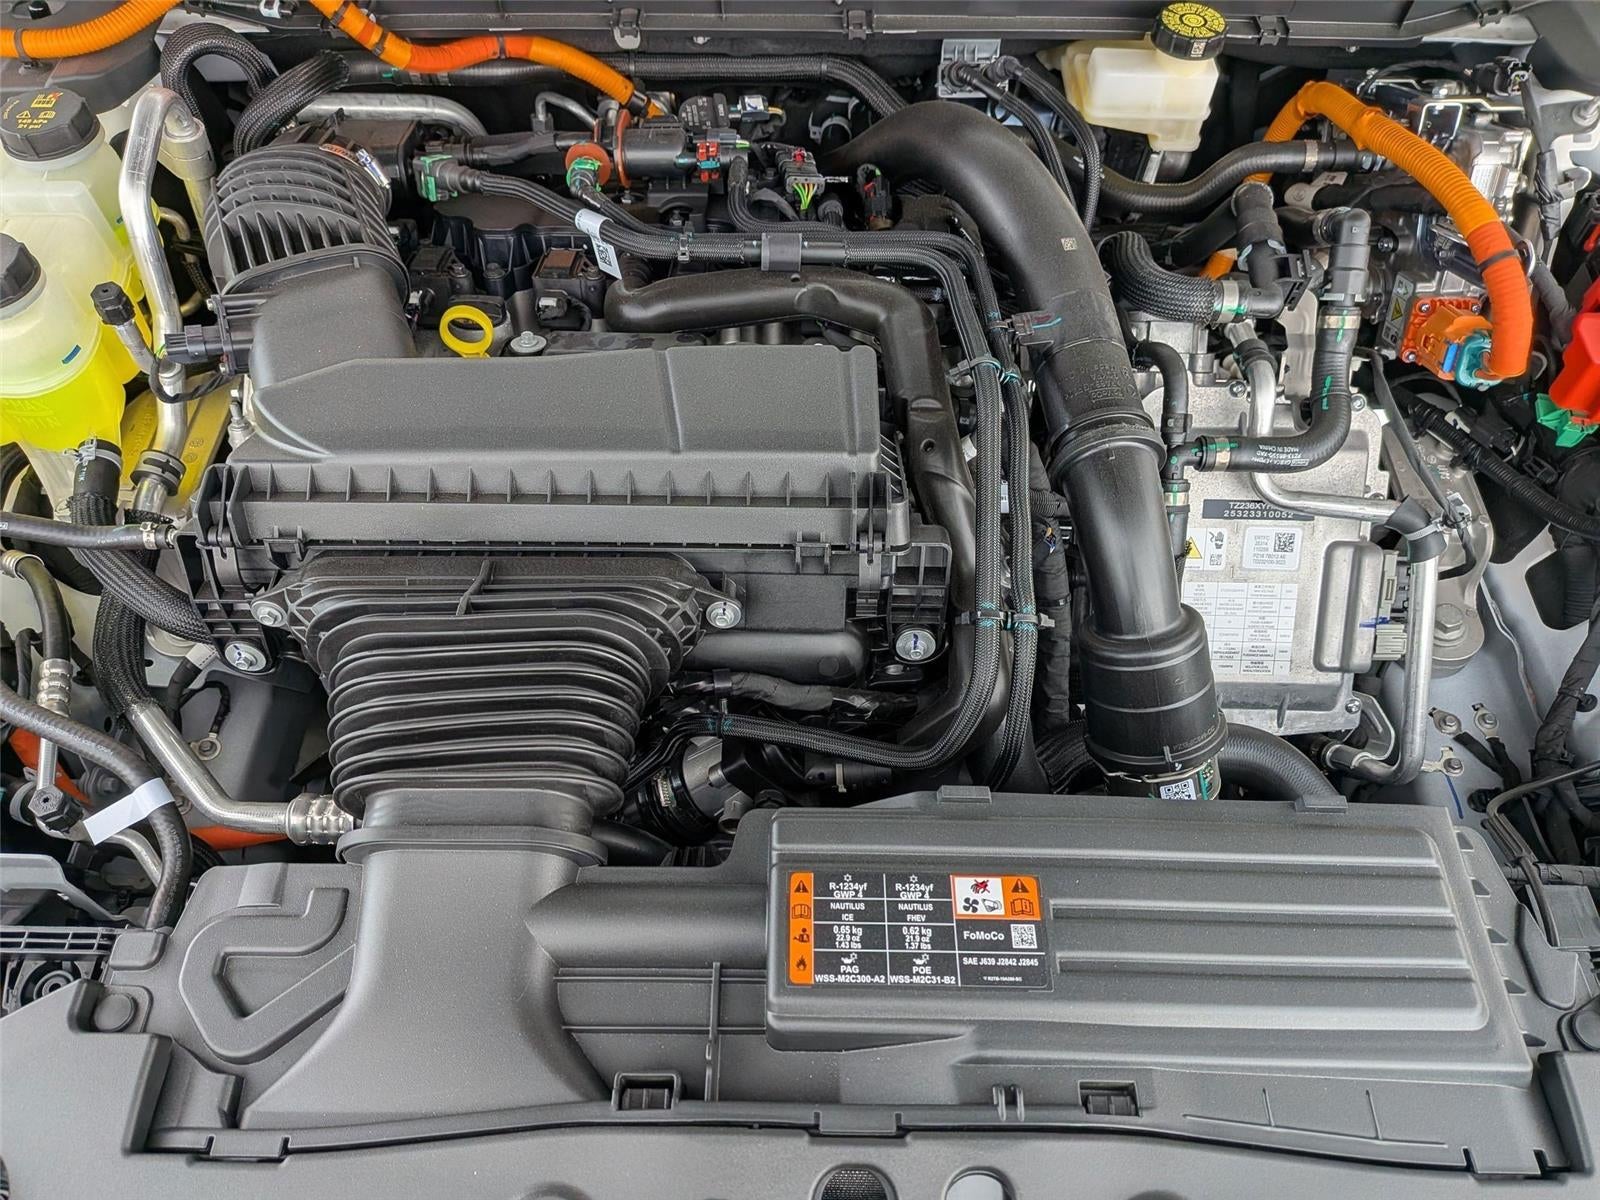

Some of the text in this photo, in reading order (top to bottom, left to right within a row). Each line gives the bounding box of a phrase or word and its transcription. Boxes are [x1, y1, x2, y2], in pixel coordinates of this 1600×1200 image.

[1258, 444, 1277, 452] CHINA
[829, 882, 868, 891] R-1234yf
[895, 883, 934, 892] R-1234yf
[833, 890, 863, 899] GWP 4
[900, 891, 930, 900] GWP 4
[830, 902, 866, 911] NAUTILUS
[898, 903, 934, 911] NAUTILUS
[841, 913, 854, 921] ICE
[906, 914, 926, 922] FHEV
[833, 925, 863, 936] 0.65 kg
[902, 926, 932, 937] 0.62 kg
[835, 934, 850, 942] 22.9
[905, 935, 920, 943] 21.9
[963, 930, 1005, 941] FoMoCo
[835, 941, 862, 949] 1.43 lbs
[905, 942, 932, 950] 1.37 lbs
[962, 957, 978, 966] SAE
[979, 957, 996, 966] J639
[840, 965, 859, 974] PAG
[912, 966, 932, 975] POE
[814, 974, 886, 983] WSS-M2C300-A2
[890, 975, 956, 985] WSS-M2C31-B2
